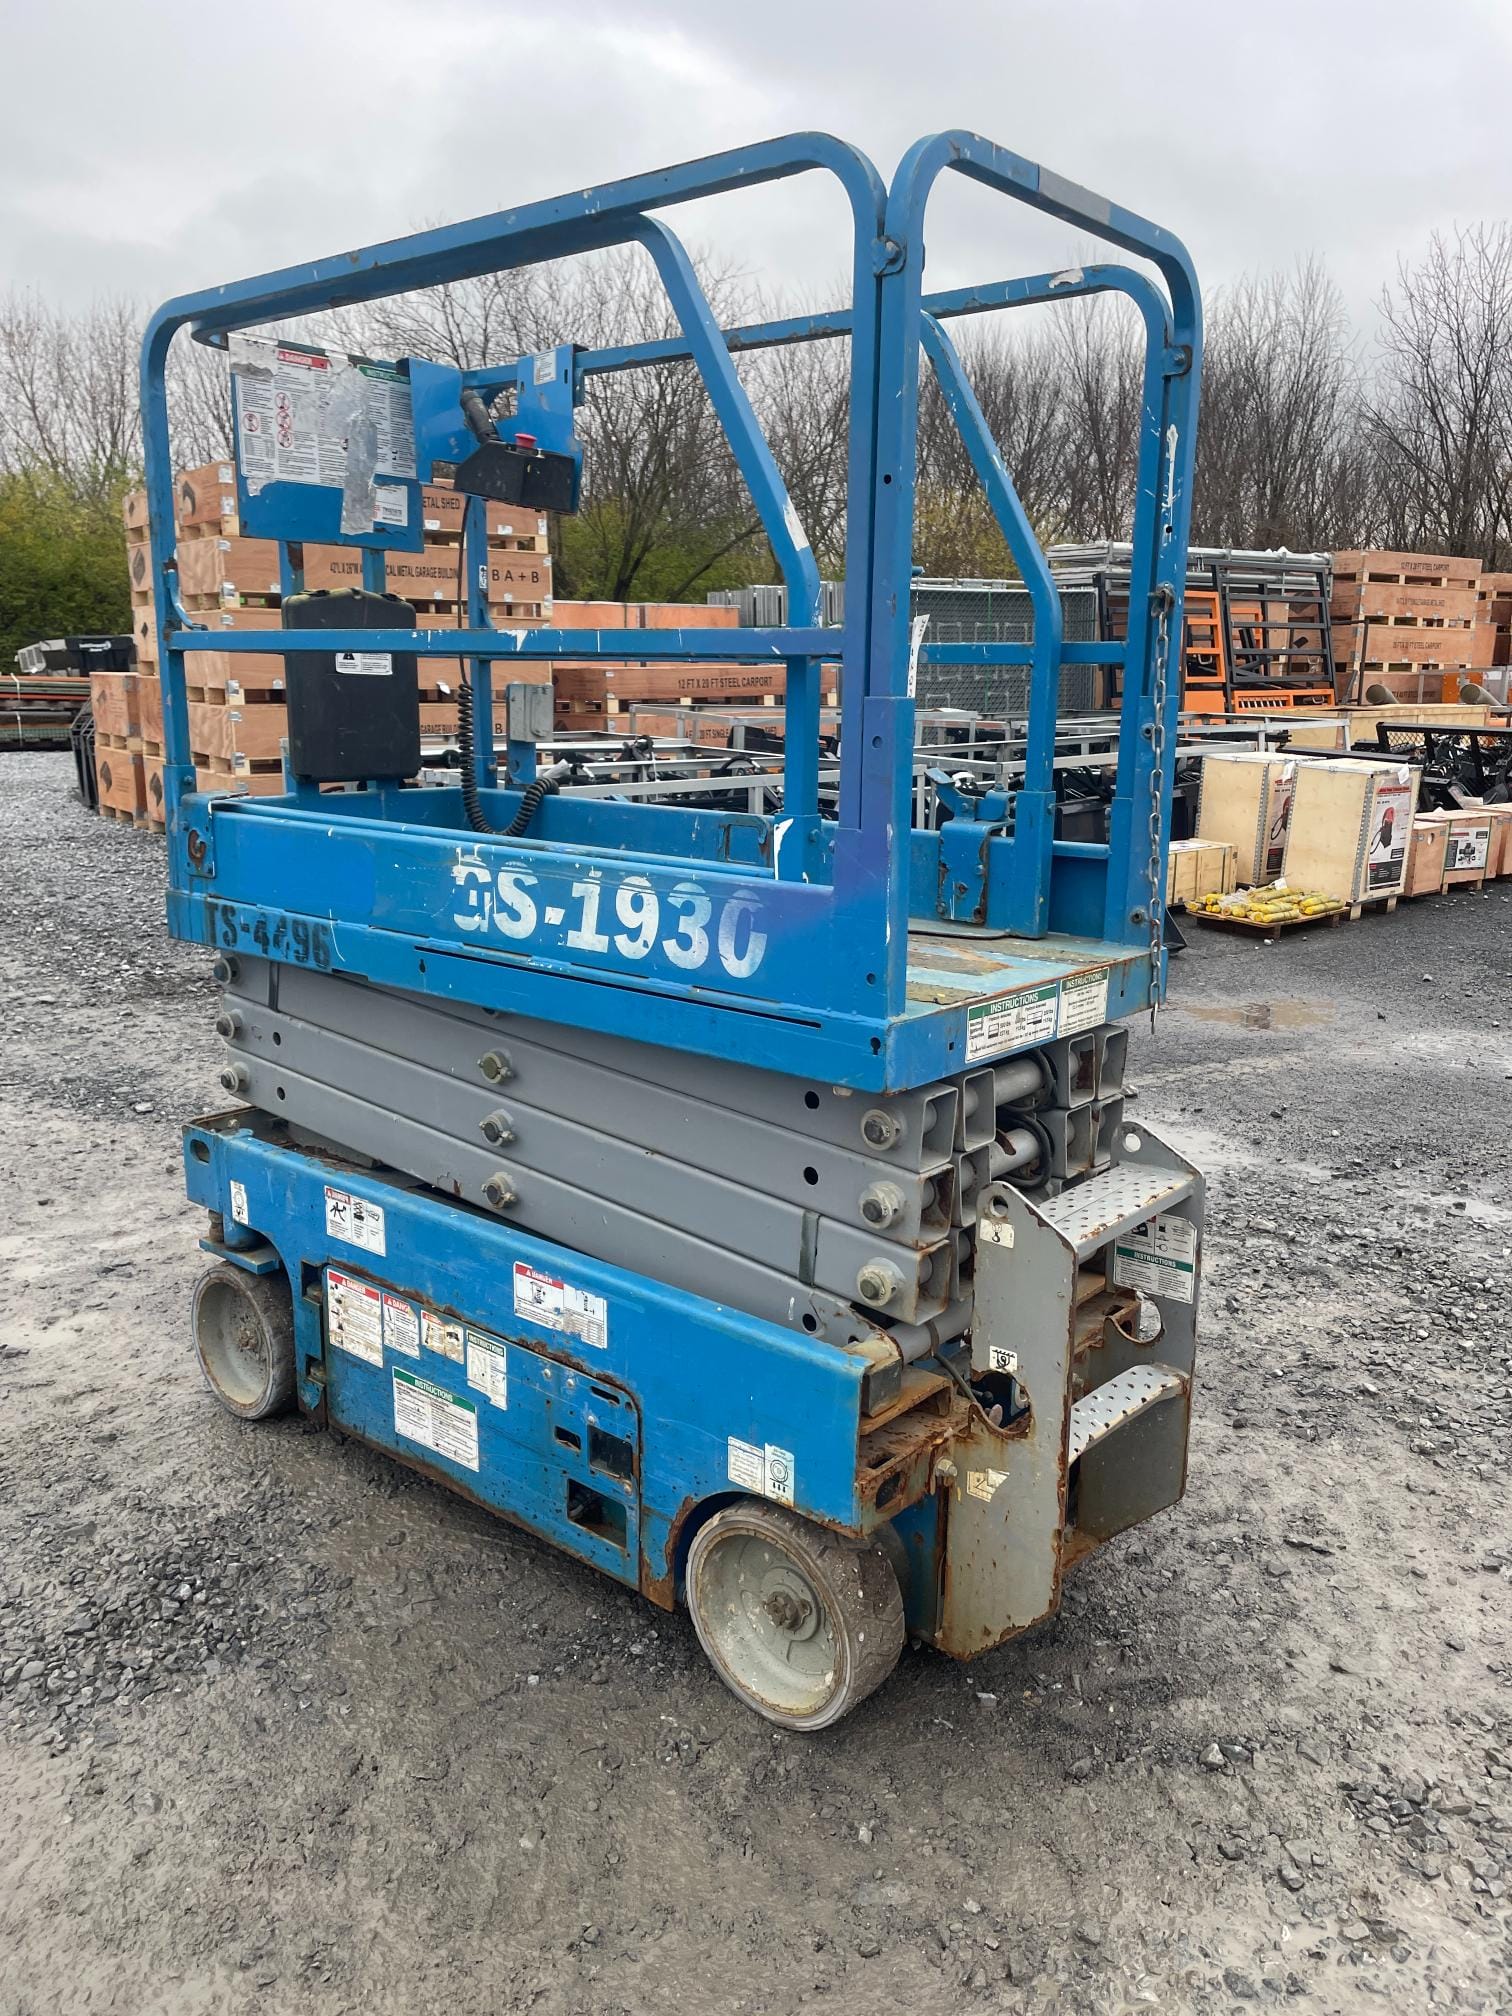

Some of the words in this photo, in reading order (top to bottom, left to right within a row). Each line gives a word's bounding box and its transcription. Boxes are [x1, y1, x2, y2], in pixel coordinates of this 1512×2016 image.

[423, 496, 440, 509] ETAL
[442, 497, 460, 510] SHED
[397, 565, 415, 577] METAL
[415, 566, 437, 579] GARAGE
[492, 565, 500, 581] B
[504, 566, 513, 582] A
[531, 568, 540, 584] B
[687, 679, 695, 688] FT
[696, 679, 701, 688] X
[711, 679, 719, 688] FT
[720, 678, 741, 688] STEEL
[742, 676, 773, 688] CARPORT
[990, 992, 1039, 1014] INSTRUCTIONS
[1134, 1251, 1177, 1268] INSTRUCTIONS
[415, 1379, 454, 1402] INSTRUCTIONS
